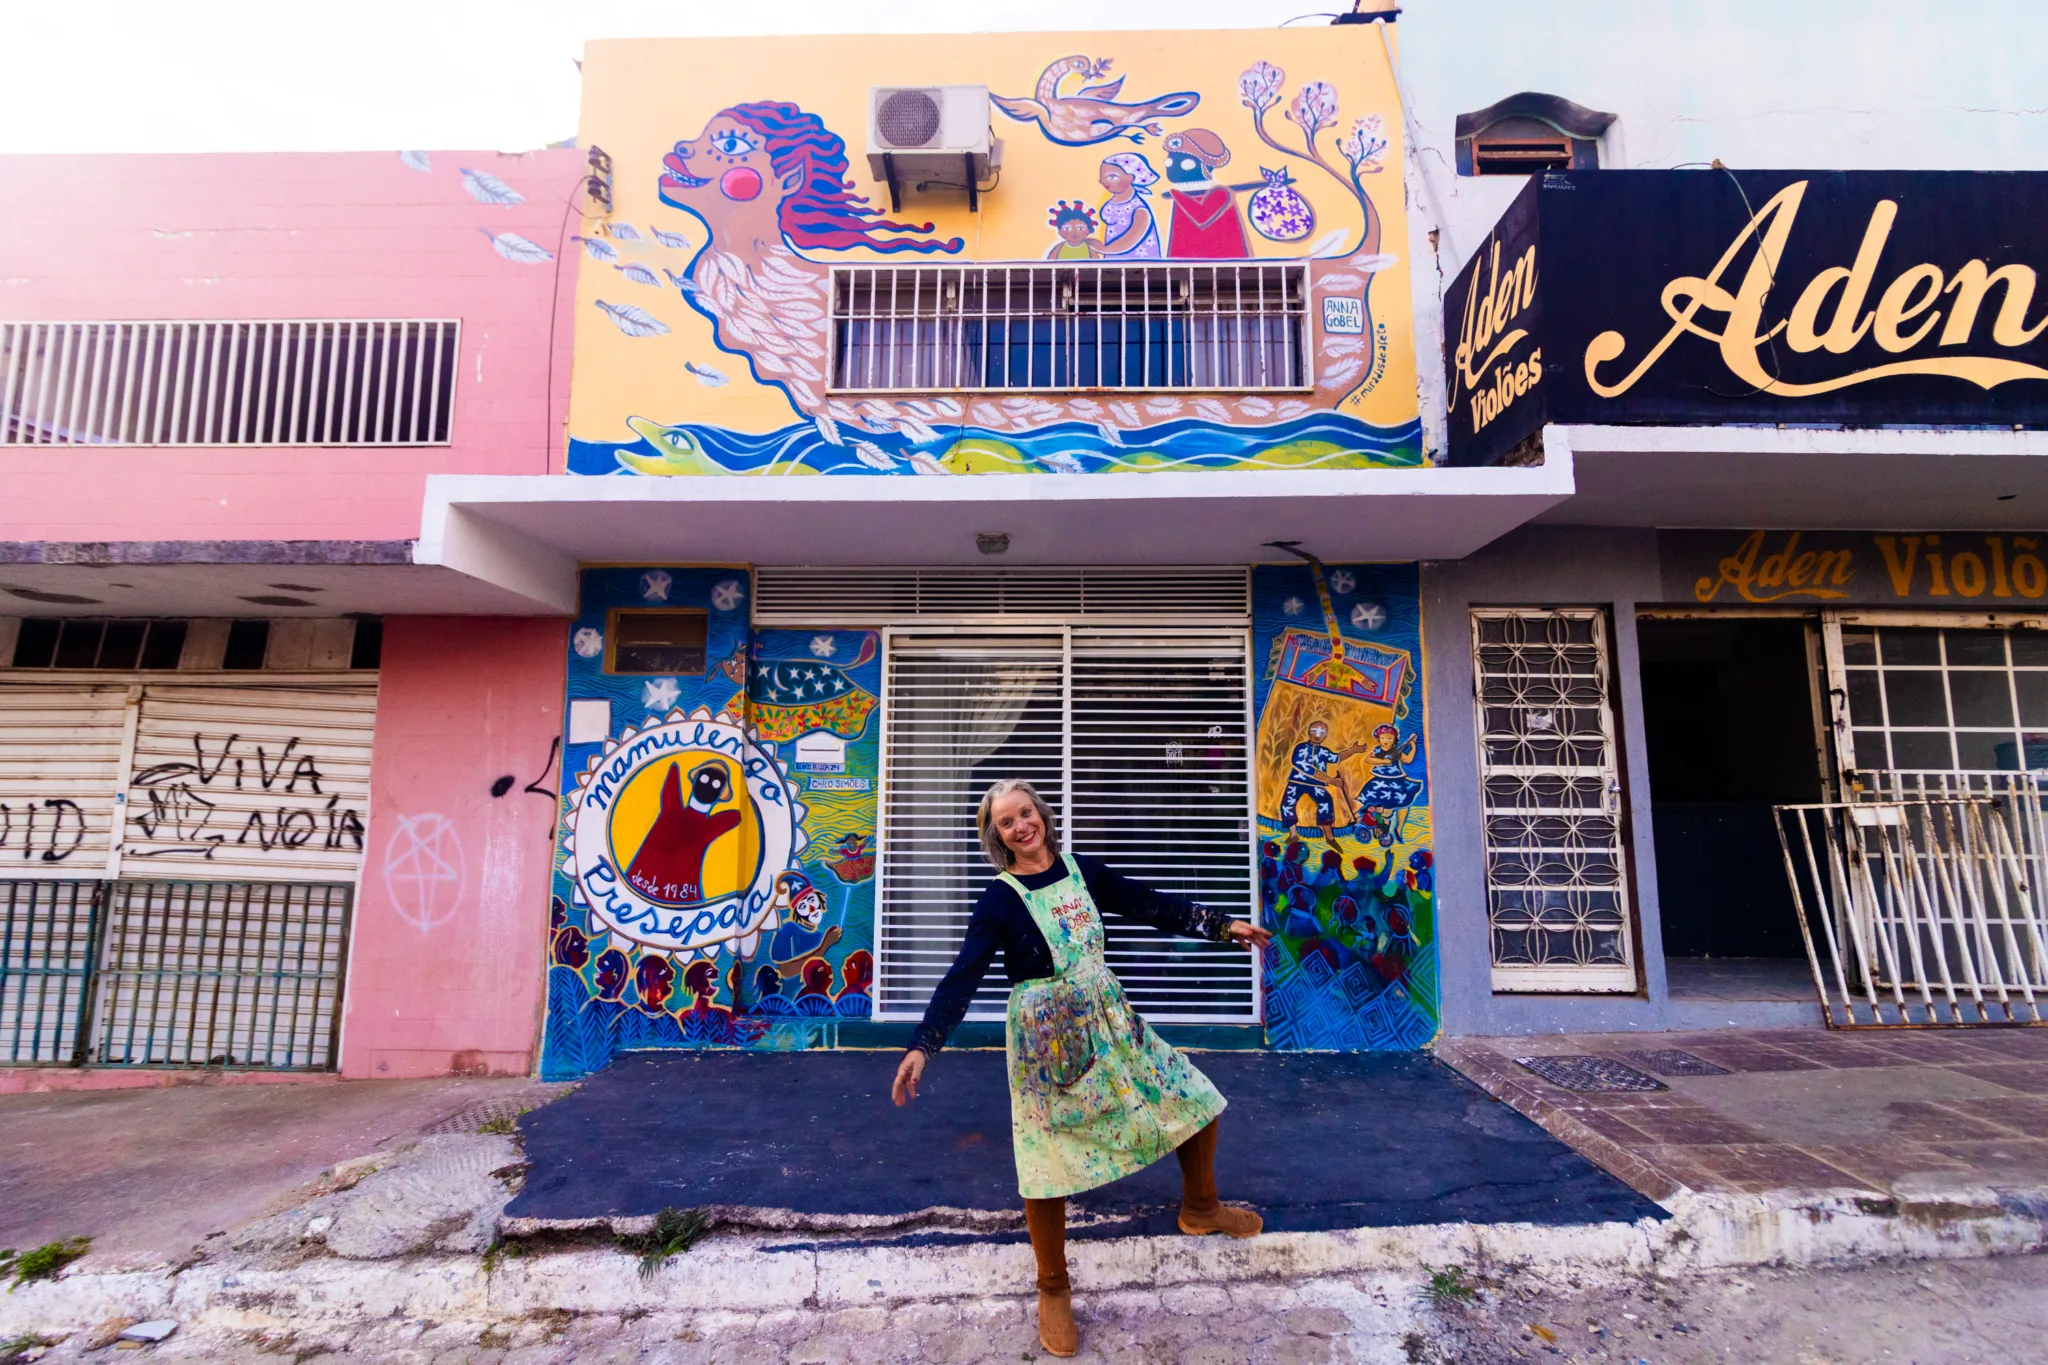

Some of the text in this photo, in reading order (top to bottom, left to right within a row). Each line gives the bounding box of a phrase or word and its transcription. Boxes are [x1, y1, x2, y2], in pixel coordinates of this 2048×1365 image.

[1326, 300, 1359, 315] ANNA
[1446, 240, 1539, 414] Aden
[1584, 180, 2048, 397] Aden
[1470, 347, 1542, 434] Violões
[1694, 530, 1855, 603] Aden
[632, 869, 697, 899] desde 1984
